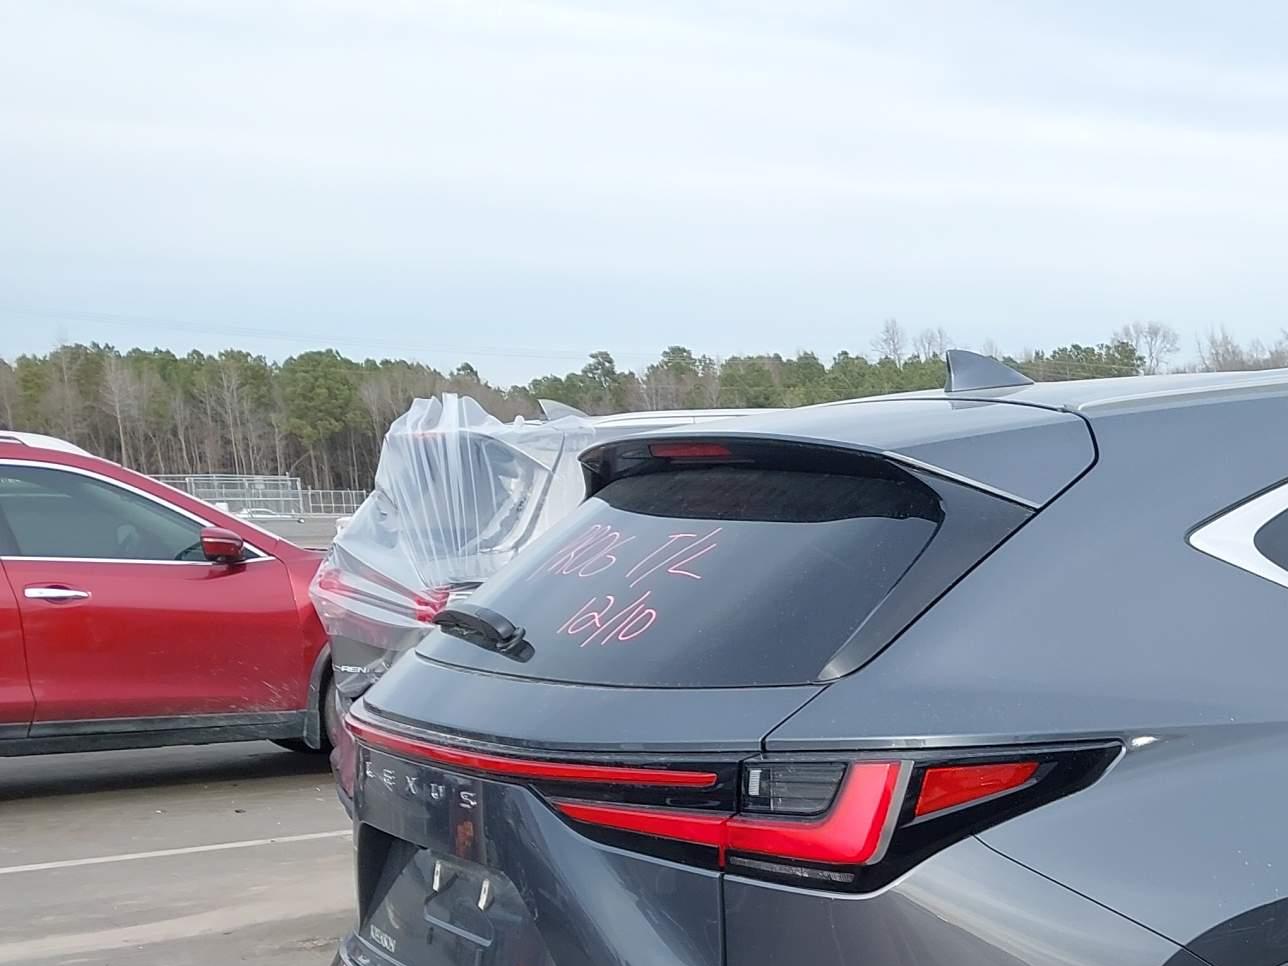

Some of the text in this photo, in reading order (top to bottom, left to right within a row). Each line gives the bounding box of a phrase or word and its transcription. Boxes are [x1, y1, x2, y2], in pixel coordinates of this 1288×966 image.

[625, 527, 722, 588] T/L
[556, 590, 657, 648] 12/10
[364, 760, 478, 810] LEXUS
